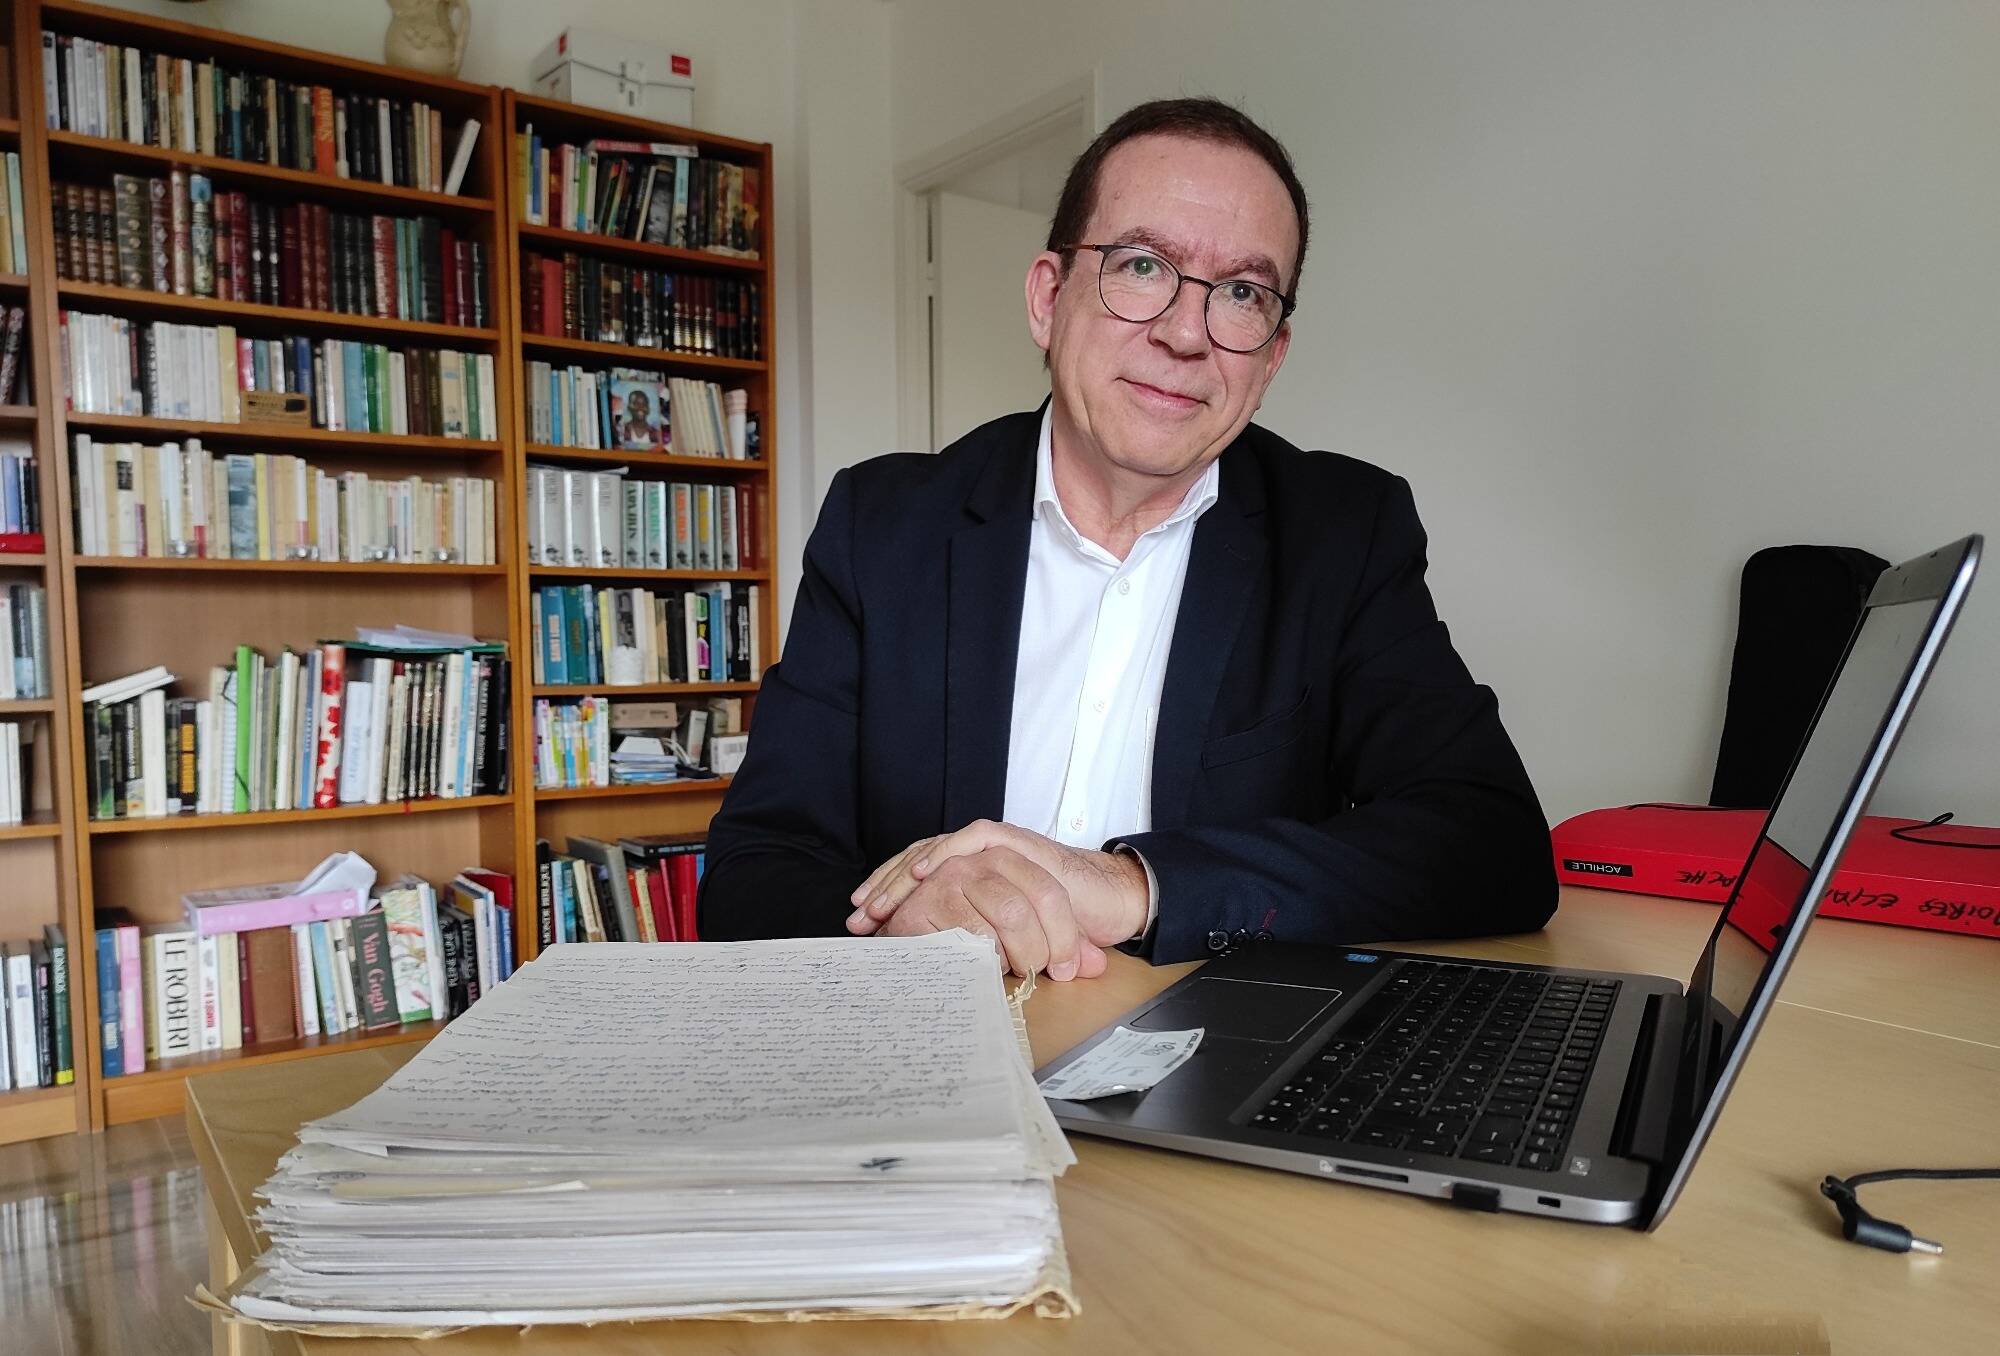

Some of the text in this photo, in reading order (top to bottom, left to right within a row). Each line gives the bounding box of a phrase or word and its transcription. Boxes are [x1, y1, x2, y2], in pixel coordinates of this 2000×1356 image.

[1571, 861, 1622, 874] ACHILLE
[164, 938, 190, 1050] LE ROBERT
[363, 932, 388, 1014] Van Gogh
